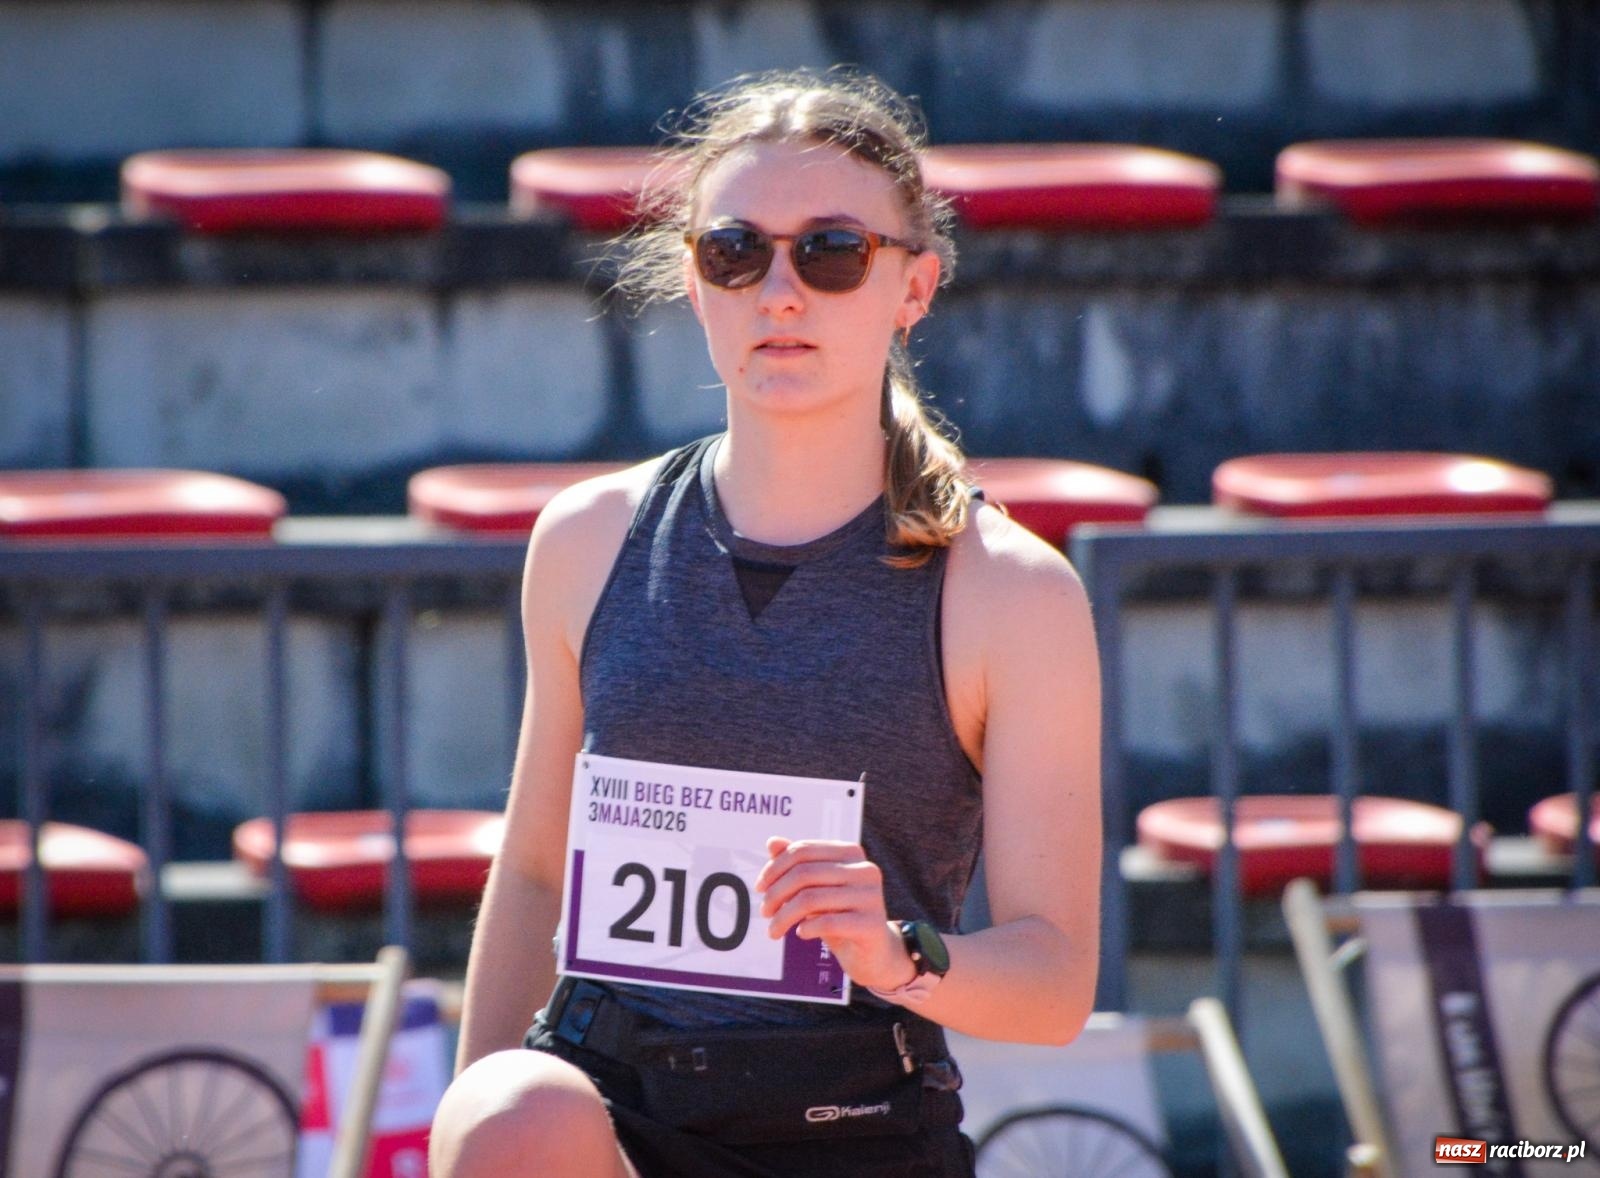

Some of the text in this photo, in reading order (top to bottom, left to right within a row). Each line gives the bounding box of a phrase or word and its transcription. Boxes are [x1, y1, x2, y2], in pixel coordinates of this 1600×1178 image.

[590, 776, 793, 817] XVIII BIEG BEZ GRANIC
[608, 862, 752, 952] 210
